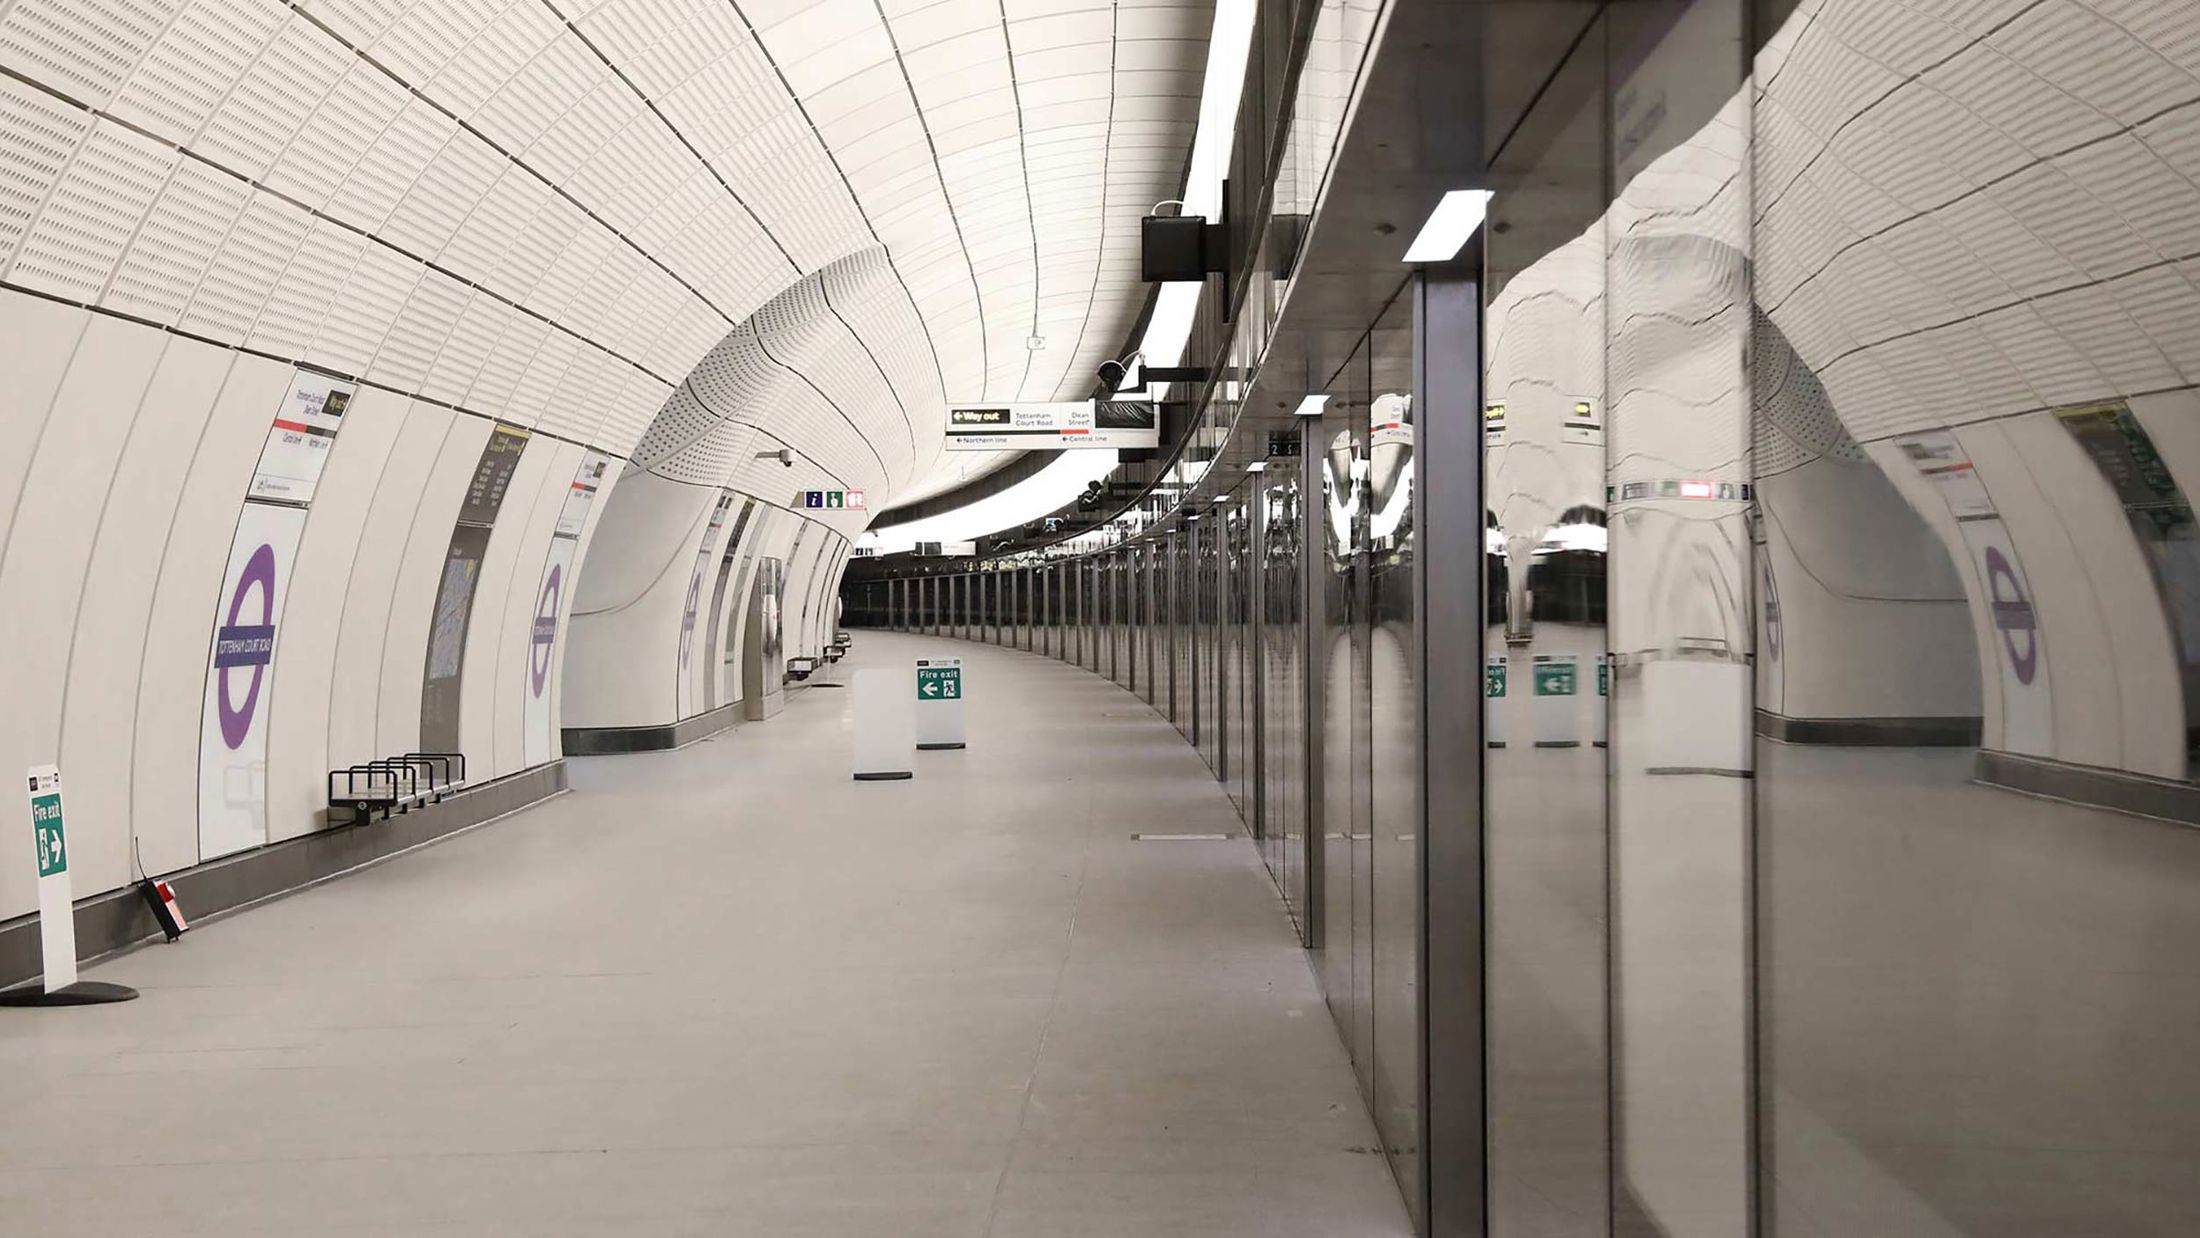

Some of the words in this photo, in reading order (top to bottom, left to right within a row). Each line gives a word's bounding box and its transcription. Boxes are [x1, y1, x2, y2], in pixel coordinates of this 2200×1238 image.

[963, 412, 982, 422] Way
[983, 412, 1000, 420] out
[1016, 412, 1051, 420] Tottenham
[1271, 444, 1278, 455] 2
[920, 670, 938, 679] Fire
[940, 669, 958, 679] exit
[34, 804, 47, 821] Fire
[48, 801, 60, 818] exit
